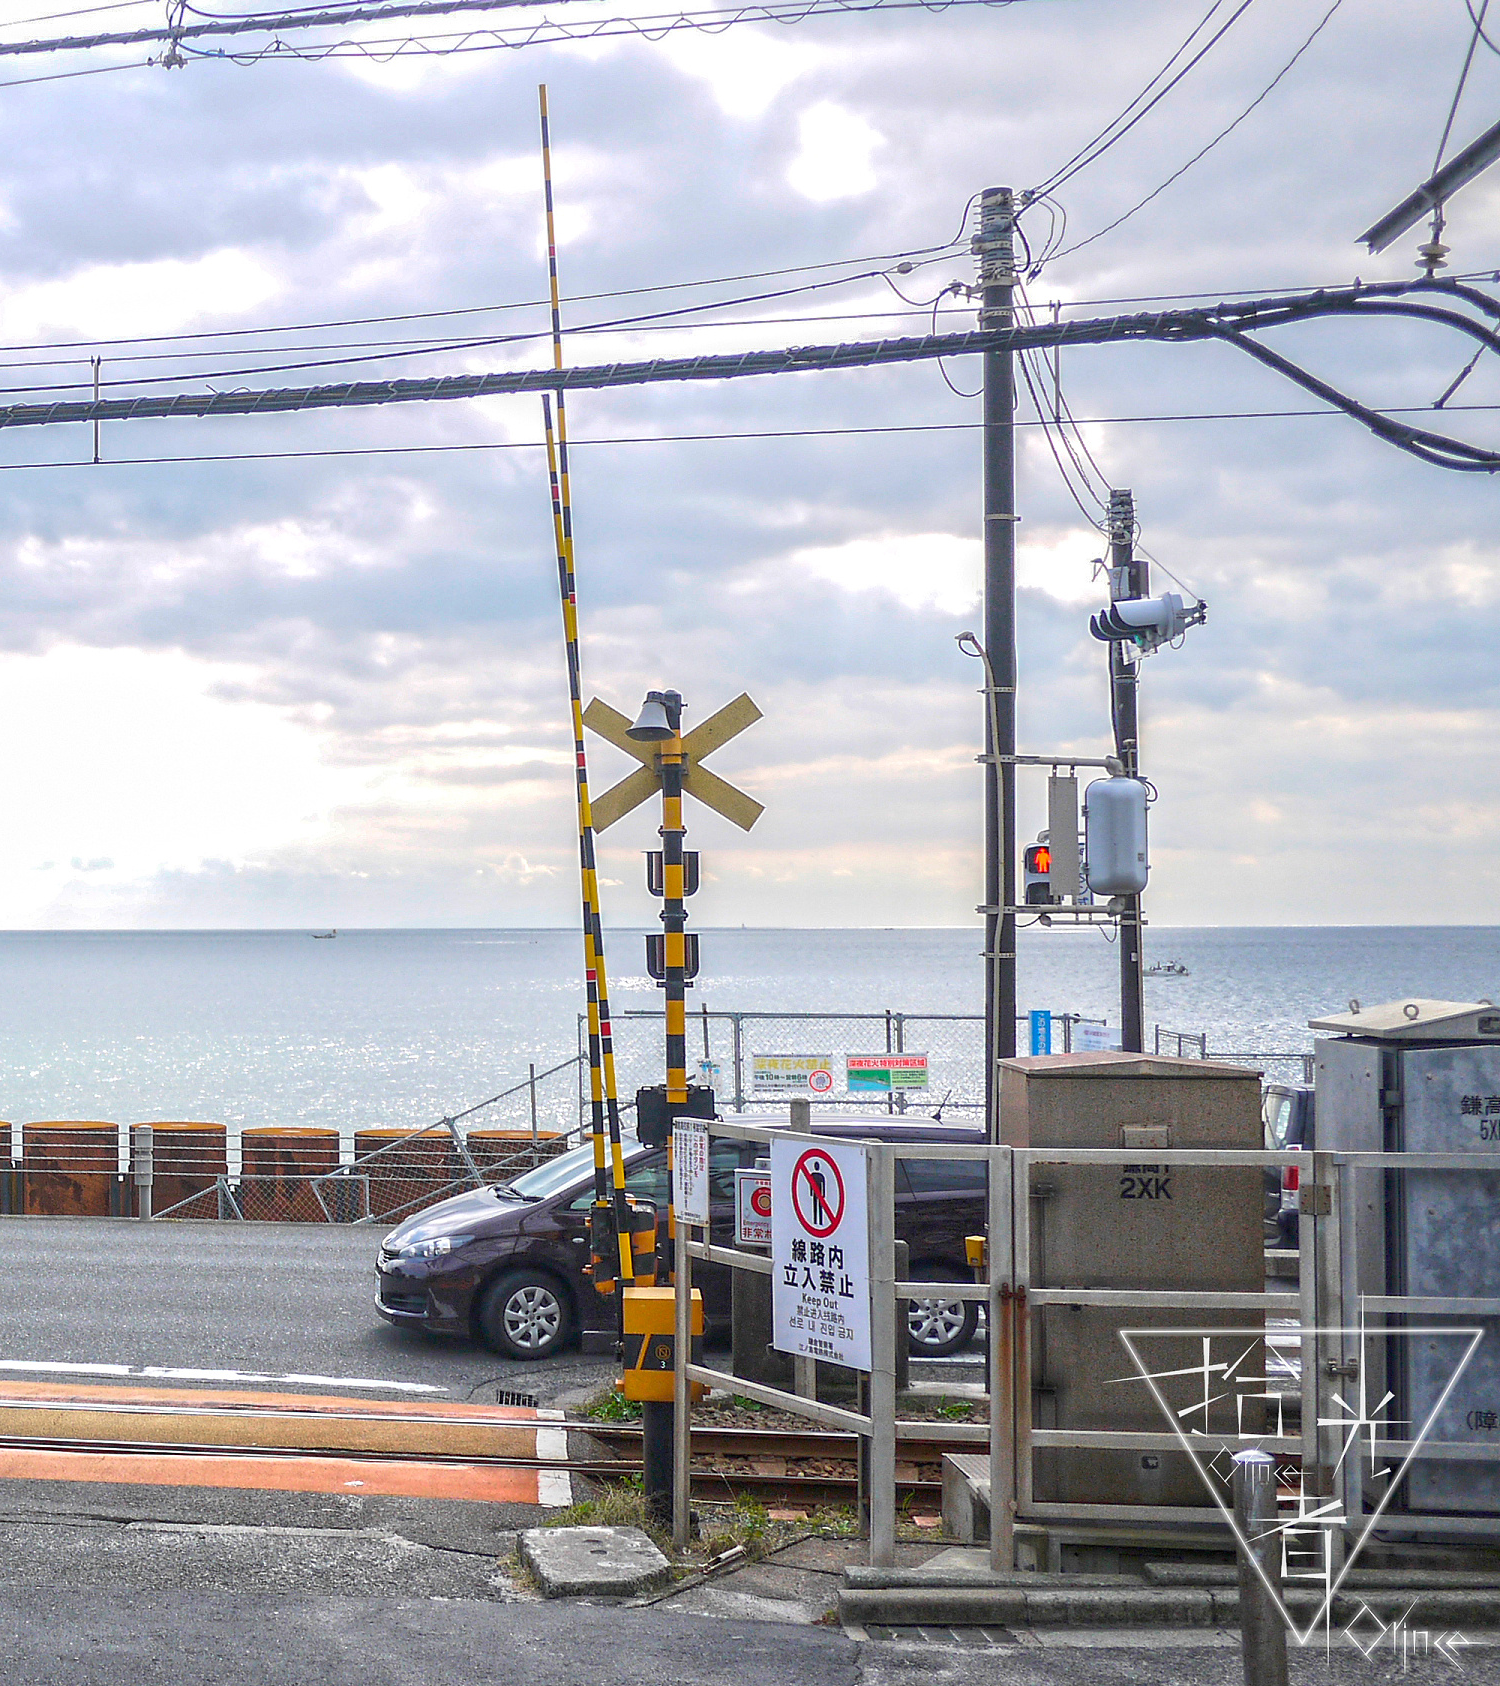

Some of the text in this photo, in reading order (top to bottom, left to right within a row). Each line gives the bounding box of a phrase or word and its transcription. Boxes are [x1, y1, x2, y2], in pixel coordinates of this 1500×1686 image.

[1480, 1119, 1500, 1140] 5X
[1120, 1177, 1172, 1200] 2XK
[792, 1238, 843, 1270] 線路内
[783, 1263, 854, 1298] 立入禁止
[802, 1293, 838, 1310] Keep Out
[660, 1360, 666, 1369] 3
